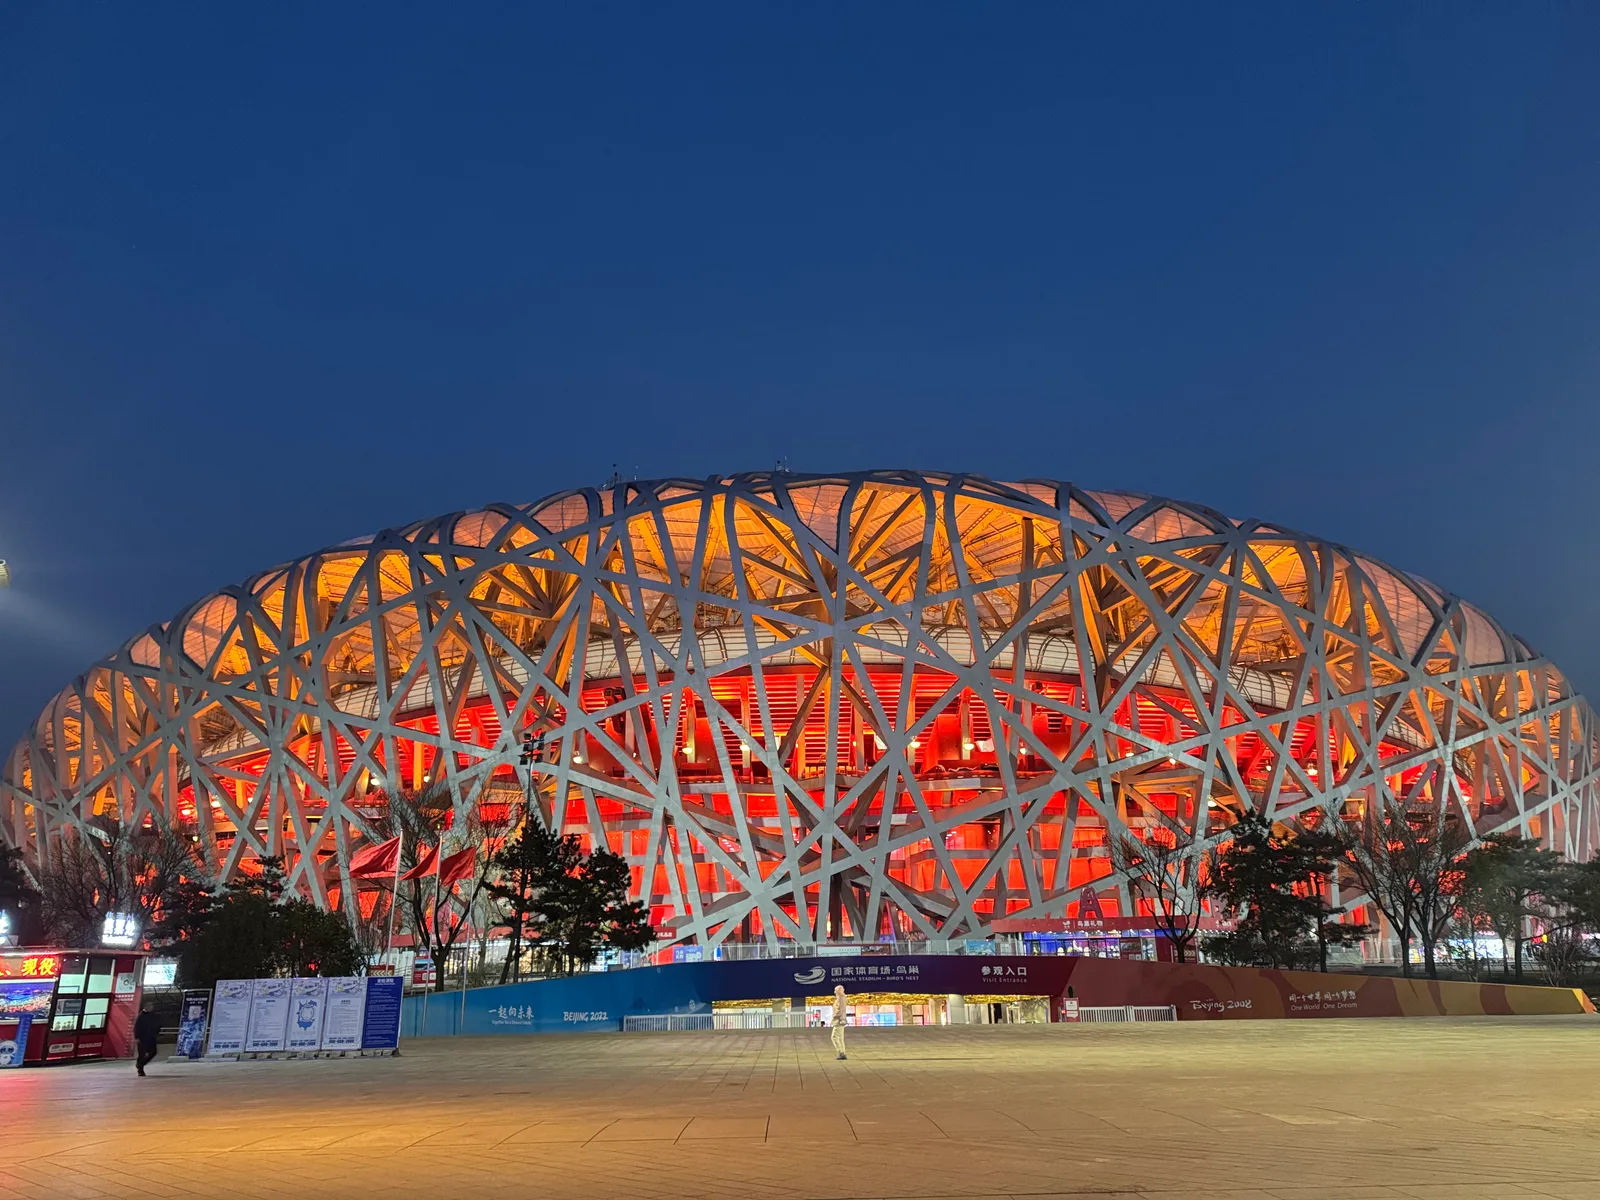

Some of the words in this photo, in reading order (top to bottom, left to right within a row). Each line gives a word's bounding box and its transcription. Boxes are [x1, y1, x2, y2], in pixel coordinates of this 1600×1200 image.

[981, 965, 1027, 976] 参观入口
[488, 1005, 534, 1019] 一起向未来
[1189, 998, 1225, 1013] Beijing
[1227, 999, 1253, 1009] 2008
[563, 1011, 588, 1024] BEIJING
[590, 1011, 608, 1021] 2022
